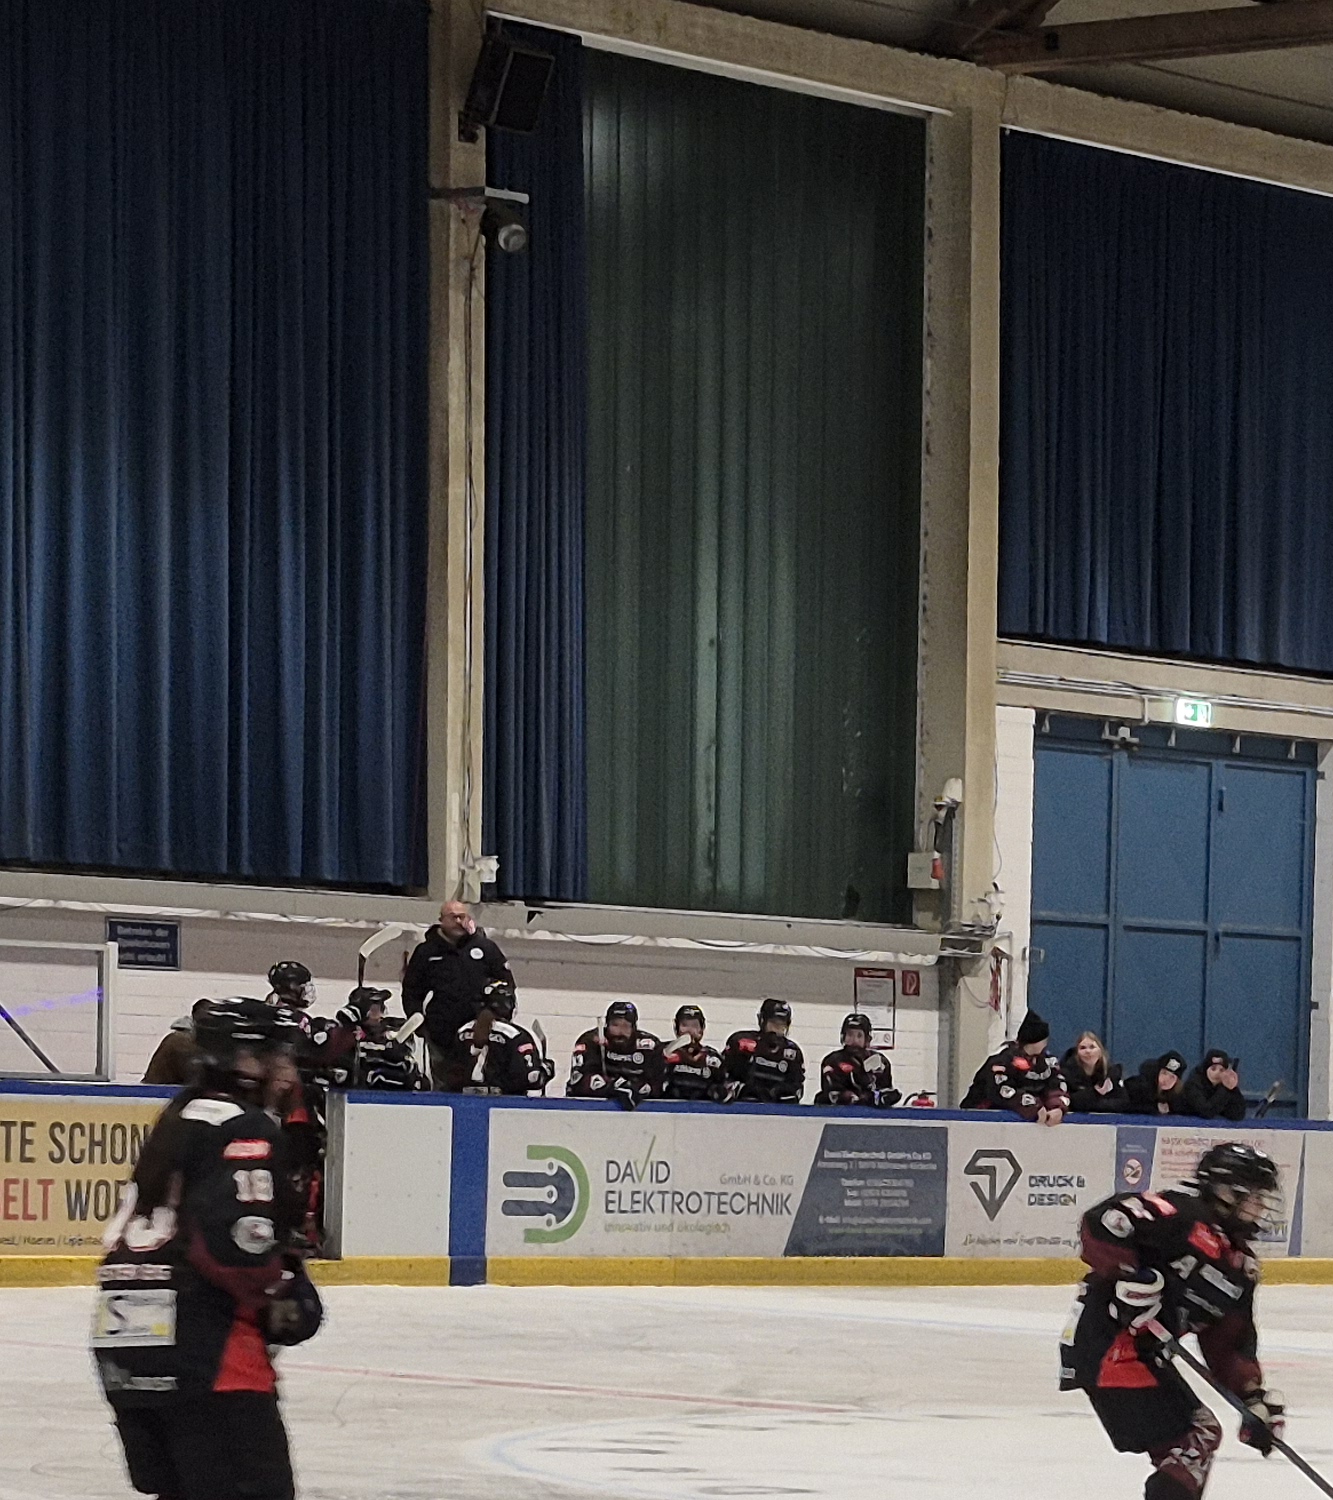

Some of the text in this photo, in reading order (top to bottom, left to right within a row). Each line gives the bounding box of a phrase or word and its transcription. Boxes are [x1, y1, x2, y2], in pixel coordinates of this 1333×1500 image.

[604, 1140, 671, 1184] DAVID
[1028, 1175, 1075, 1187] DRUCK
[604, 1190, 793, 1216] ELEKTROTECHNIK
[1027, 1193, 1077, 1206] DESIGN
